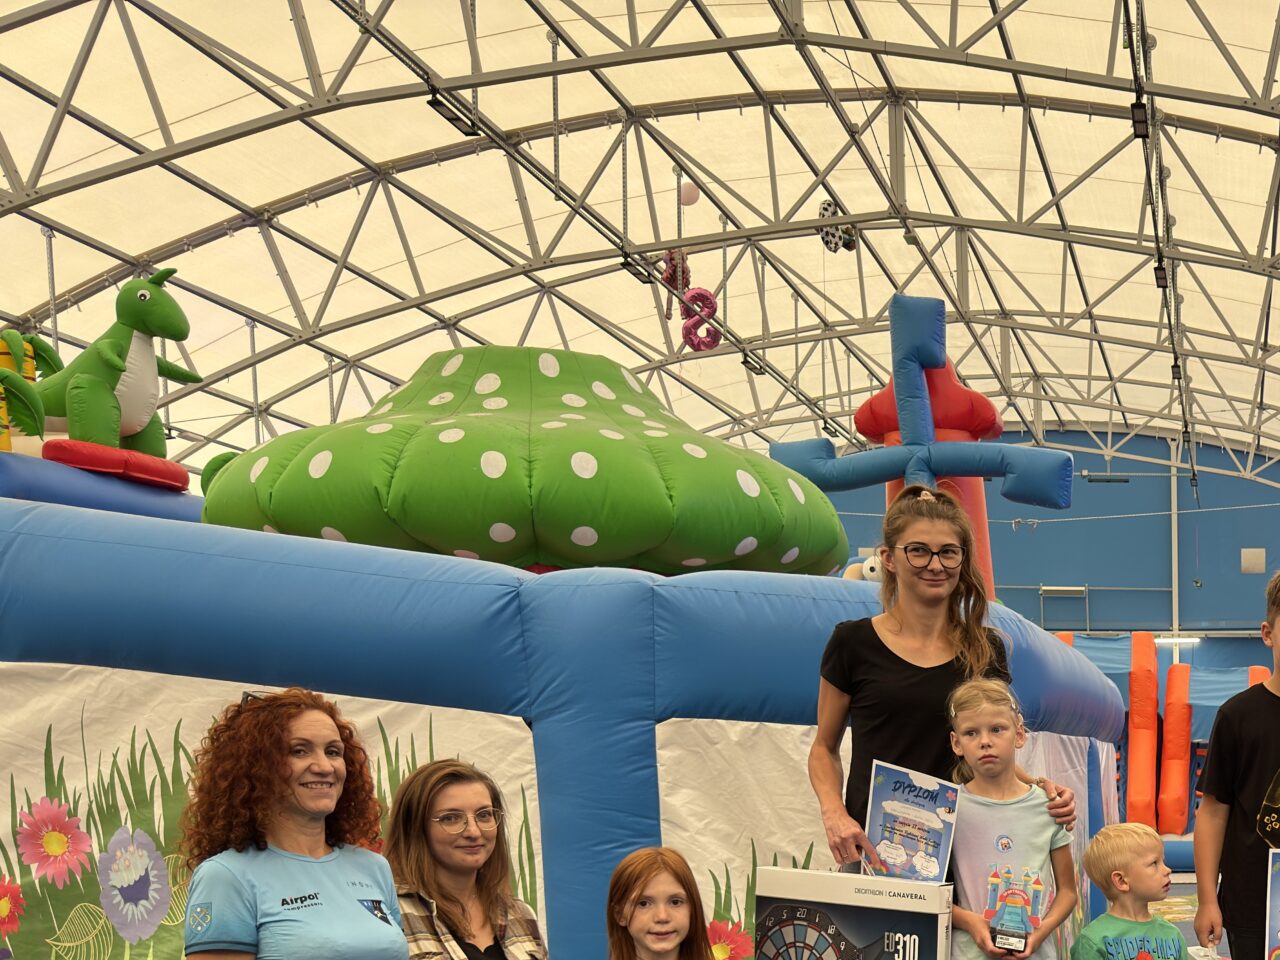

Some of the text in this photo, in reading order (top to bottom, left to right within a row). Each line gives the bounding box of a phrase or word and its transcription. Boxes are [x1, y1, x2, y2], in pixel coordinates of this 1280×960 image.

[892, 780, 940, 804] DYPLOM
[281, 892, 319, 907] Airpol
[888, 891, 927, 901] CANAVERAL
[796, 908, 808, 918] 20
[827, 924, 837, 935] 18
